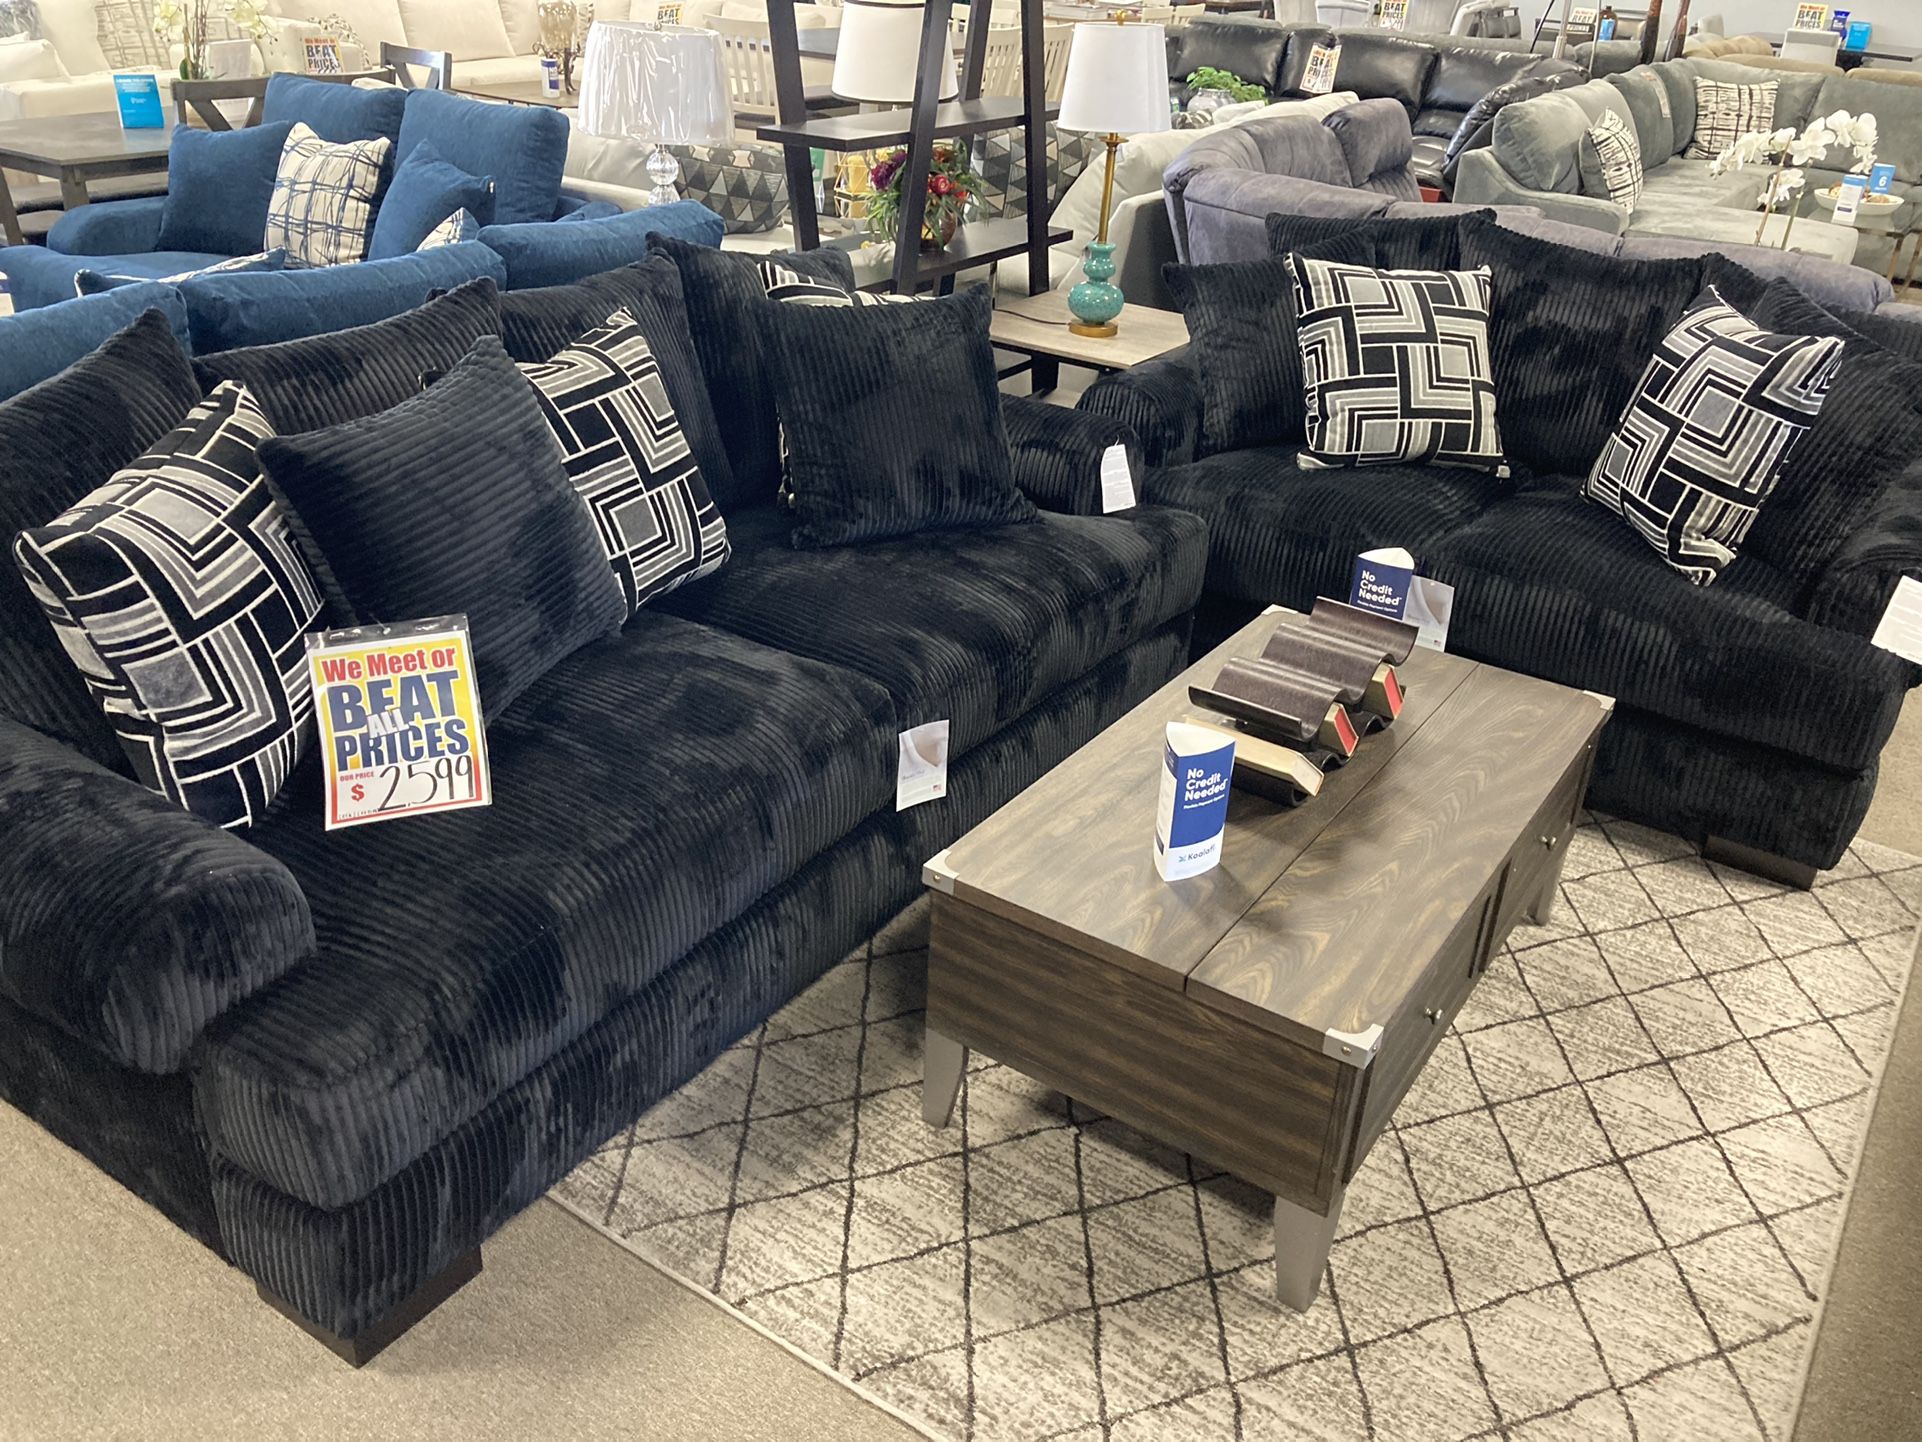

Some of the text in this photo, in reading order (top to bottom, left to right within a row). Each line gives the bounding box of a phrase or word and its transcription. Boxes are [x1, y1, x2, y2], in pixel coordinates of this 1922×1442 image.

[1384, 3, 1406, 11] BEAT
[657, 8, 680, 20] BEAT
[1798, 10, 1824, 20] BEAT
[1795, 19, 1821, 28] PRICES
[306, 45, 337, 58] BEAT
[1879, 175, 1888, 187] 6
[1361, 570, 1376, 582] No
[1360, 580, 1393, 596] Credit
[322, 647, 456, 683] We Meet or
[327, 670, 459, 733] BEAT
[366, 708, 410, 738] ALL
[334, 718, 470, 772] PRICES
[340, 771, 374, 782] OUR PRICE
[1187, 768, 1204, 780] No
[351, 755, 474, 812] $ 2599
[1185, 773, 1221, 790] Credit
